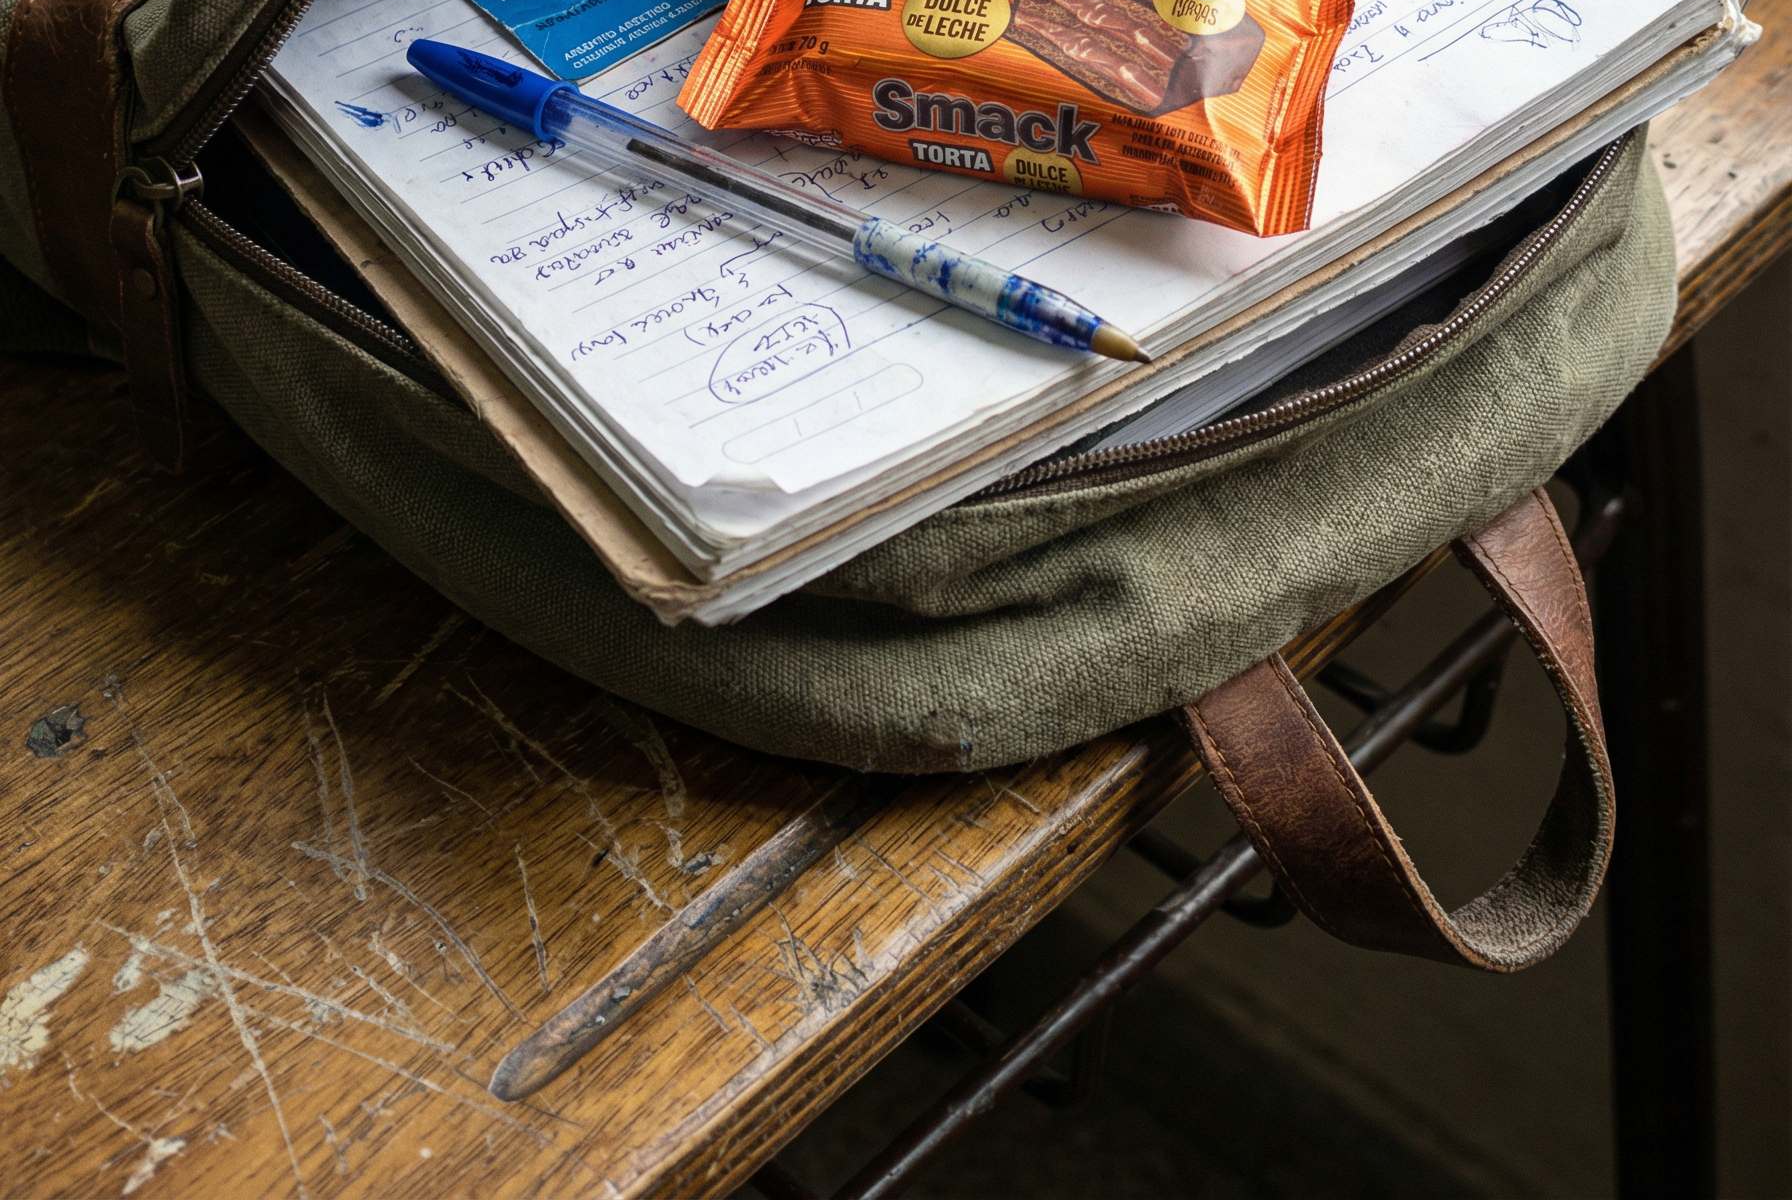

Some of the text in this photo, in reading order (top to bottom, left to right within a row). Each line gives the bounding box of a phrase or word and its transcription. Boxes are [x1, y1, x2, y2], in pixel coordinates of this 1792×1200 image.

[906, 13, 990, 43] DE LECHE
[799, 35, 817, 50] 70
[818, 40, 830, 55] g
[872, 77, 1101, 165] Smack
[912, 142, 992, 171] TORTA
[1015, 158, 1069, 183] DULCE
